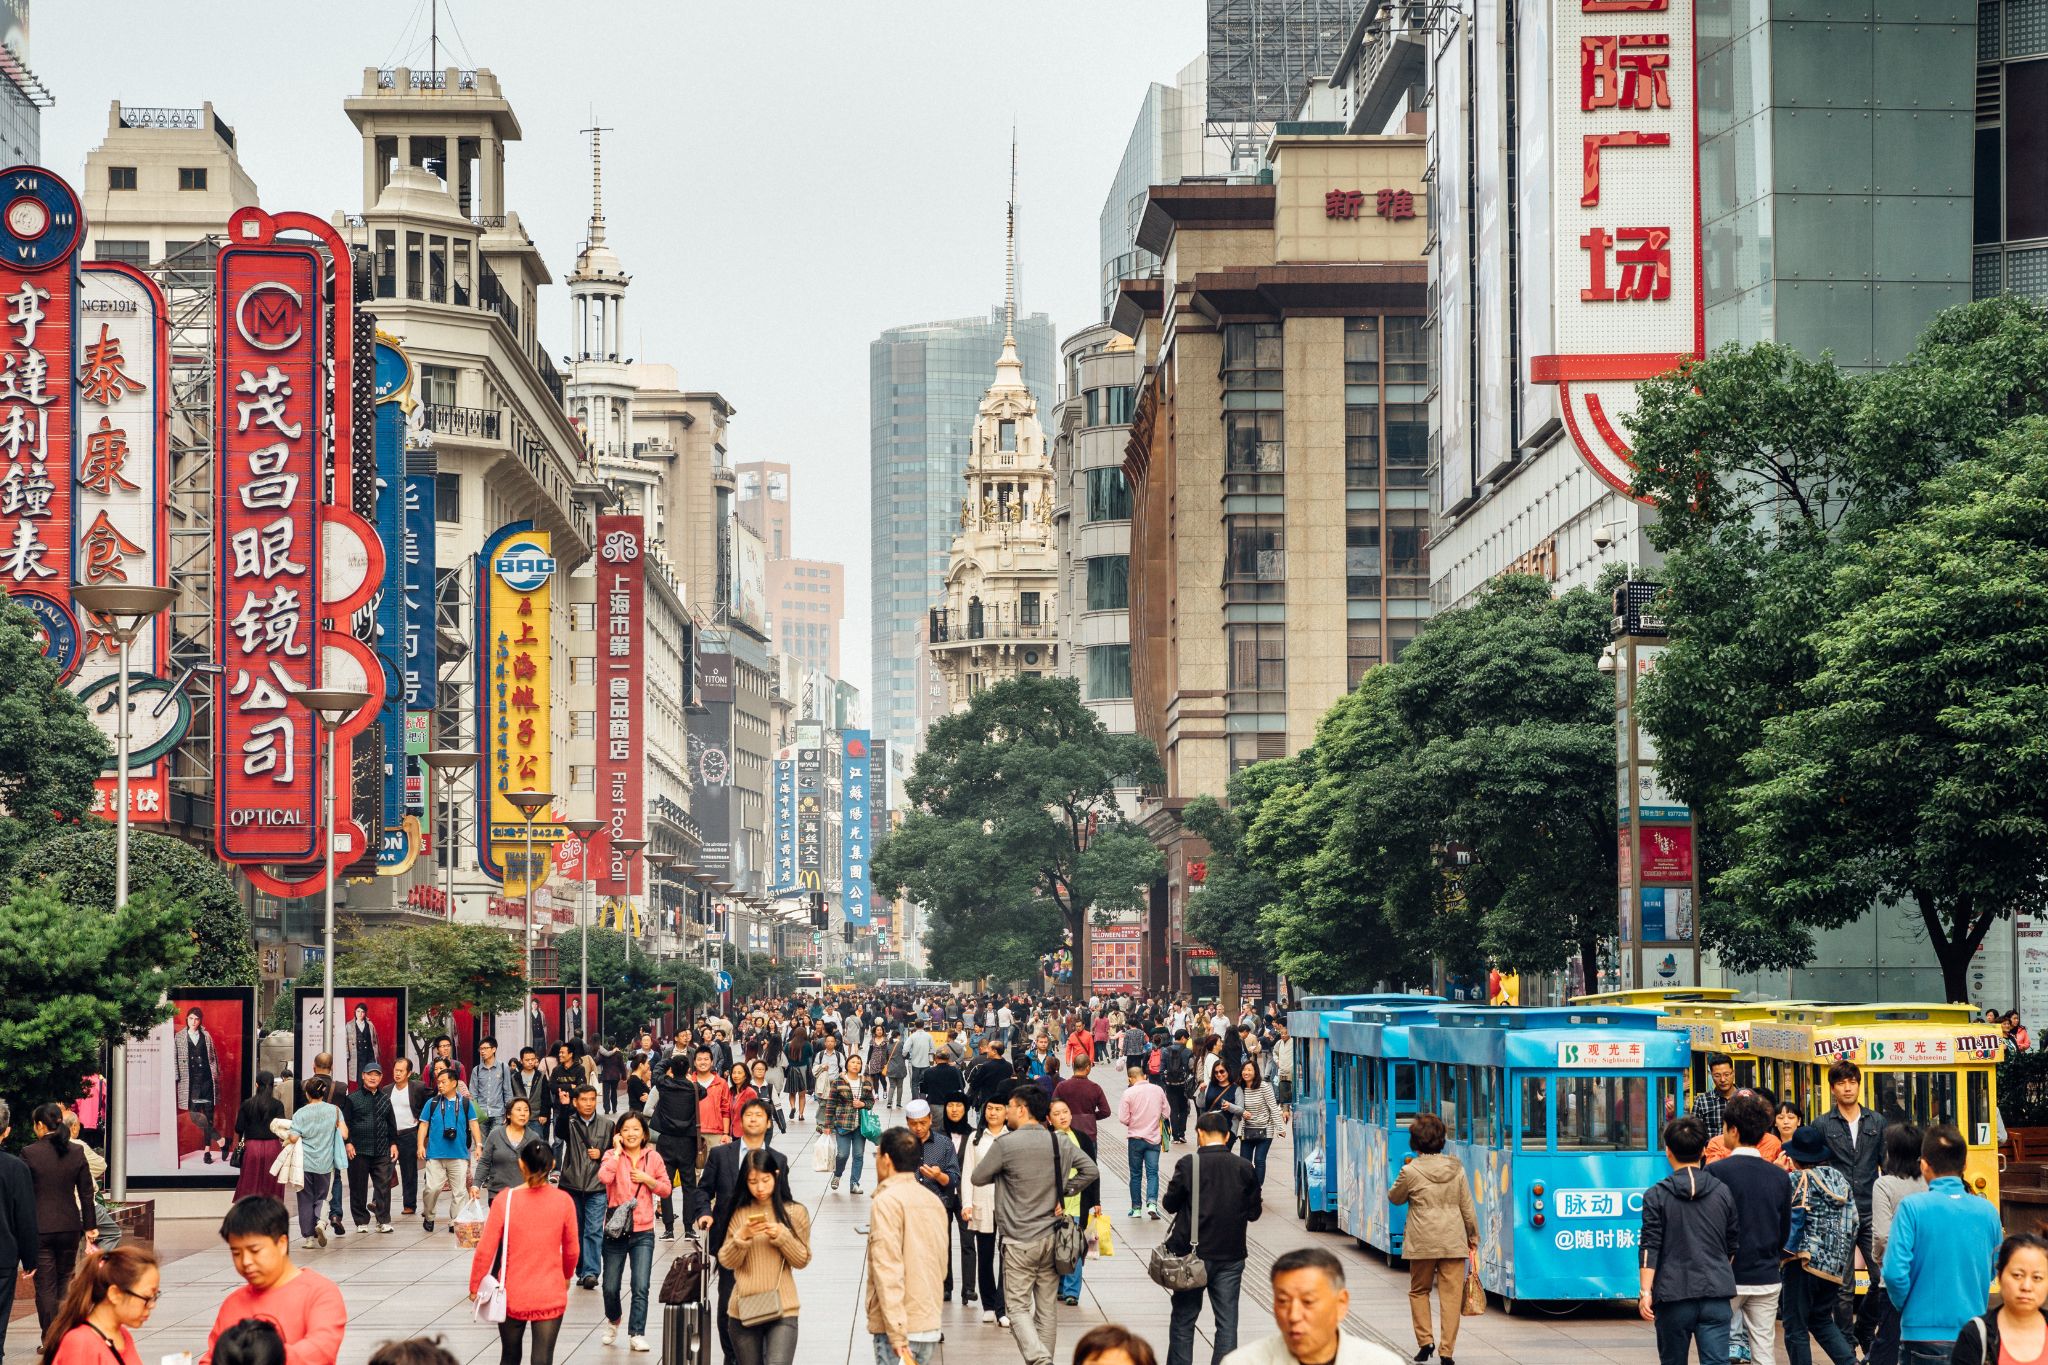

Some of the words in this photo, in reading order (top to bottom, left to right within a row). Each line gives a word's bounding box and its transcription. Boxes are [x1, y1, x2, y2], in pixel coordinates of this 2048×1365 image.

[1580, 0, 1671, 302] 际广场
[1325, 188, 1416, 221] 新雅
[230, 365, 308, 783] 茂昌眼镜公司
[496, 559, 555, 573] BAC
[609, 573, 631, 760] 上海市第一食品商店
[705, 675, 728, 684] TITONI
[611, 771, 627, 804] First
[230, 808, 306, 826] OPTICAL
[491, 826, 565, 838] 创建于942年
[849, 766, 864, 918] 江蘇陽光集團公司
[804, 821, 819, 865] 真丝大王
[505, 851, 546, 860] SHANHAI
[309, 1002, 336, 1024] lil
[1588, 1043, 1640, 1056] 观光车
[1894, 1041, 1947, 1053] 观光车
[1980, 1126, 1988, 1143] 7
[1564, 1194, 1613, 1215] 脉动
